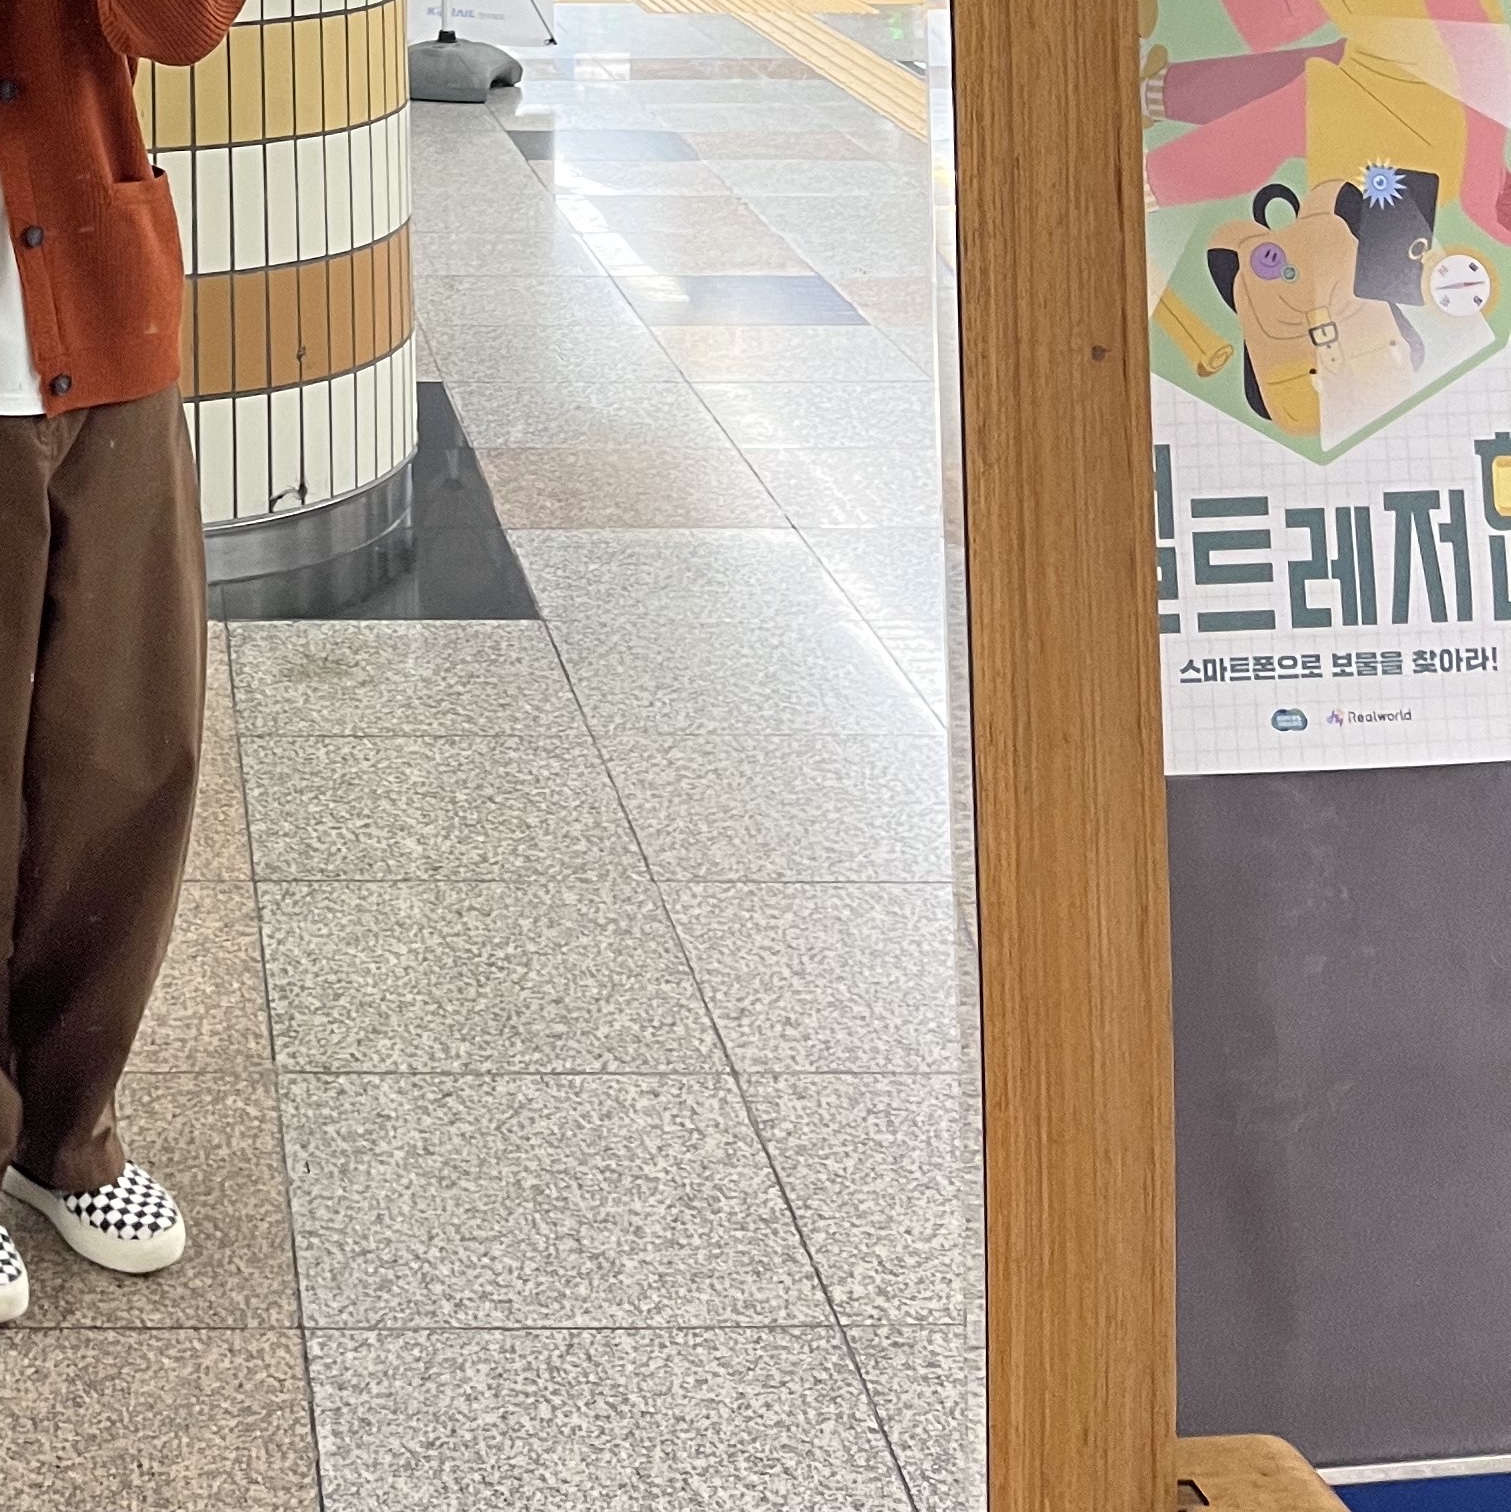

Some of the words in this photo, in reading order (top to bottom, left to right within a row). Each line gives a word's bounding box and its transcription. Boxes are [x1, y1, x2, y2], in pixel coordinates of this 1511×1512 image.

[427, 7, 476, 18] KRAIL
[1179, 652, 1324, 684] 스마트폰으로
[1331, 650, 1404, 677] 보물을
[1412, 646, 1499, 675] 찾아라!
[1348, 709, 1413, 724] Realworld
